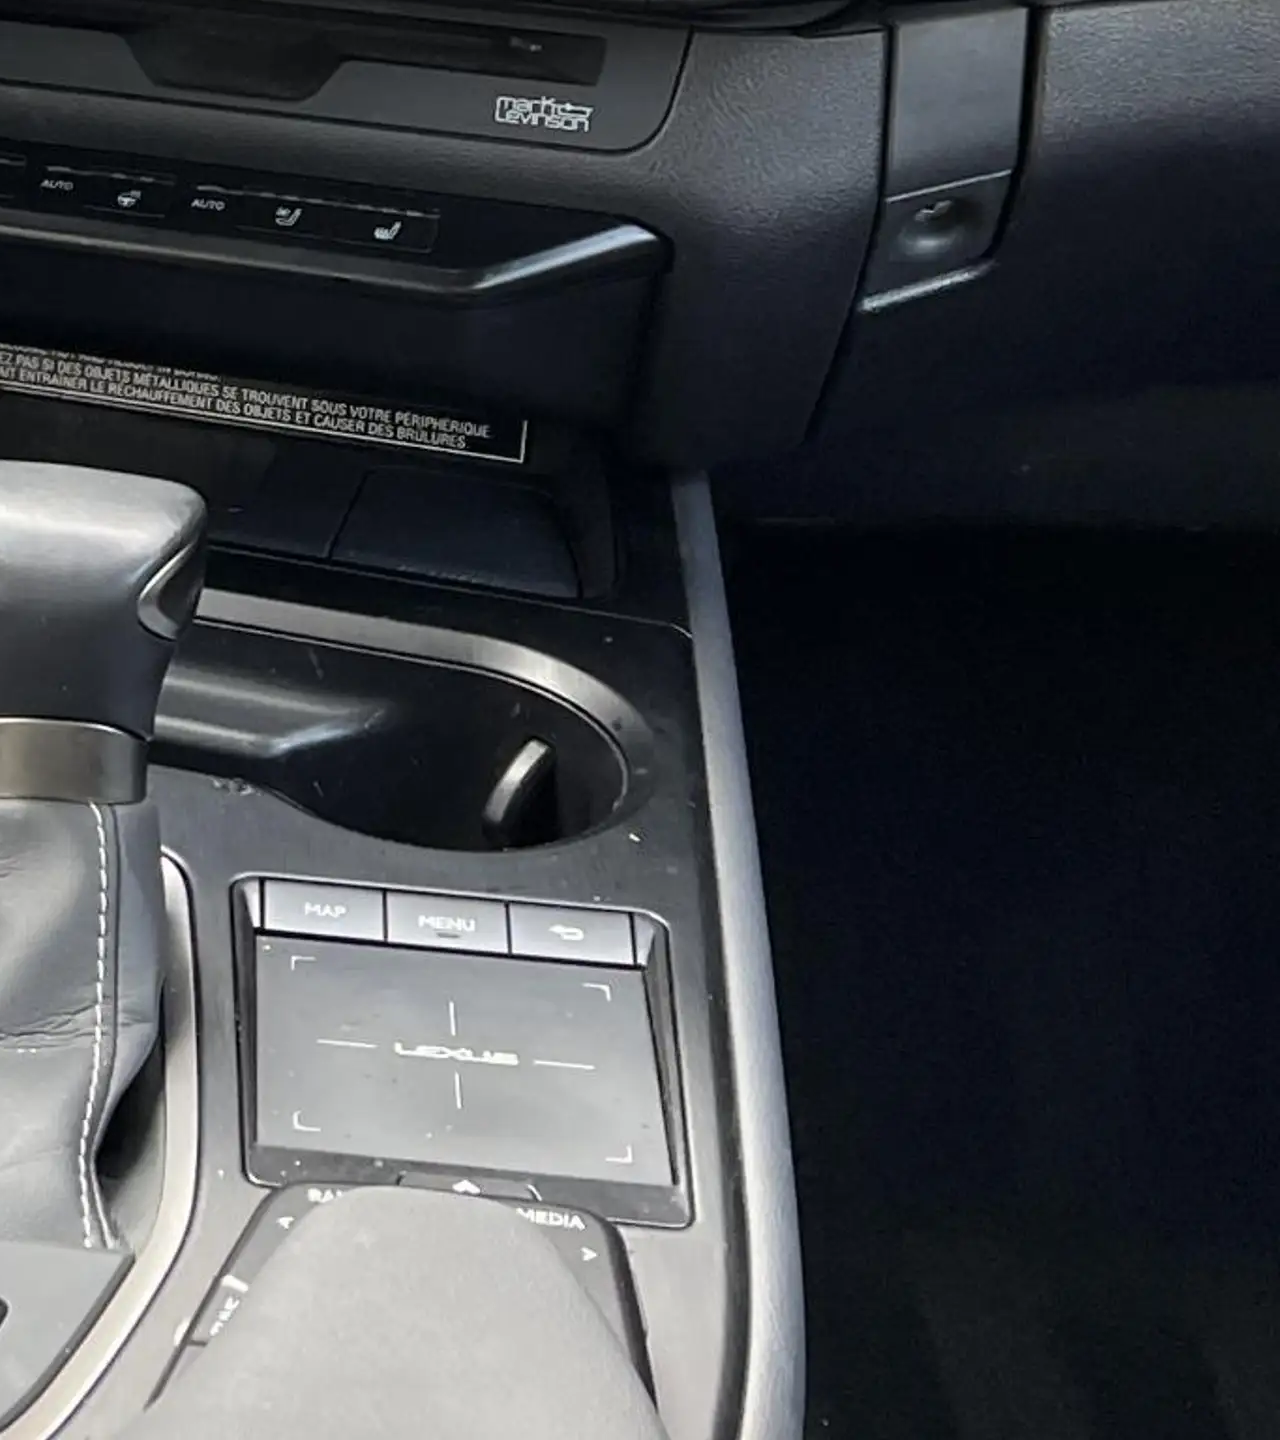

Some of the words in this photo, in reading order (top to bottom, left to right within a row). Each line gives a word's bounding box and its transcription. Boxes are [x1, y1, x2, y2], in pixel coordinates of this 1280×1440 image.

[40, 178, 74, 192] AUTO
[191, 197, 226, 212] AUTO
[16, 352, 38, 367] PAS
[57, 358, 82, 374] DES
[84, 362, 130, 383] OBJETS
[222, 385, 238, 398] SE
[241, 388, 308, 411] TROUVENT
[311, 399, 347, 417] SOUS
[350, 404, 391, 424] VOTRE
[90, 379, 106, 394] LE
[215, 398, 241, 414] DES
[243, 403, 291, 422] OBJETS
[295, 411, 310, 425] ET
[313, 413, 366, 434] CAUSER
[368, 421, 394, 438] DES
[304, 902, 347, 918] MAP
[418, 915, 476, 932] MENU
[394, 1042, 519, 1065] LEXUS
[516, 1208, 585, 1231] MEDIA
